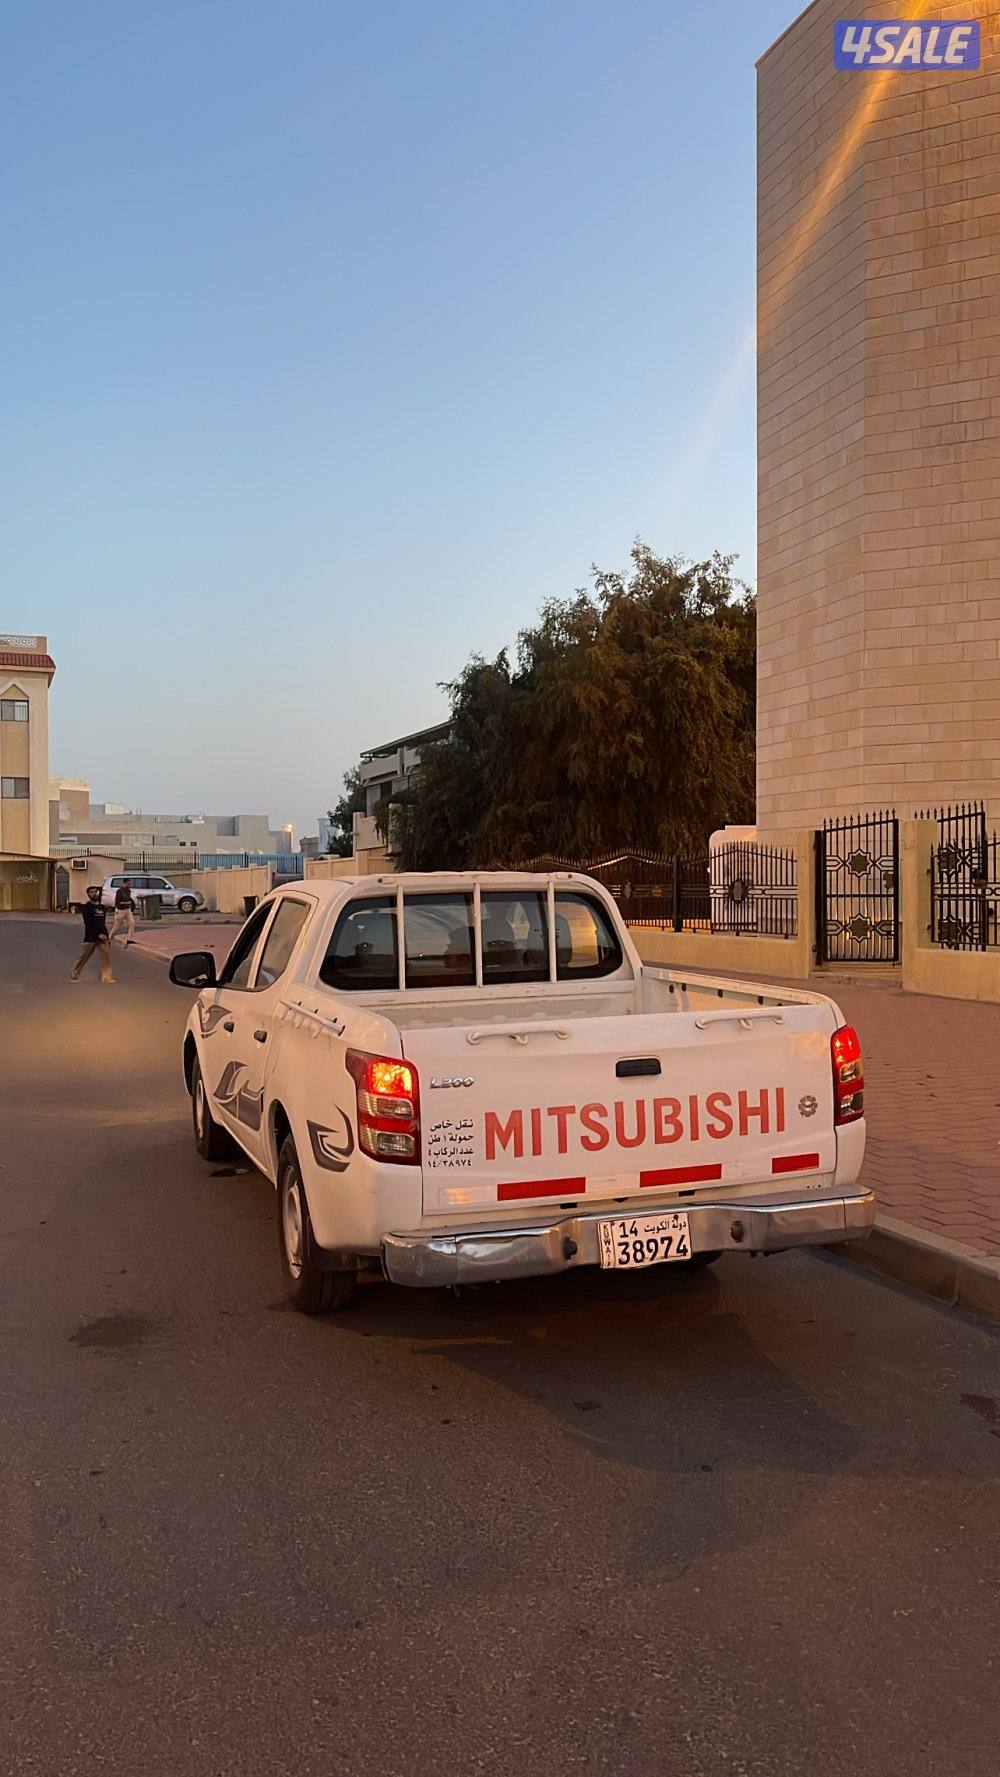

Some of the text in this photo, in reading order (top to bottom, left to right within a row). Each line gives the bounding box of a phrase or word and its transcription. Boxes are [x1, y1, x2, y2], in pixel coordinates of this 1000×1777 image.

[455, 1119, 474, 1130] نقل
[484, 1087, 784, 1160] MITSUBISHI
[427, 1134, 441, 1145] طن
[449, 1133, 474, 1144] حمولة
[619, 1221, 638, 1238] 14
[644, 1219, 687, 1235] دولة الكويت
[617, 1235, 689, 1265] 38974
